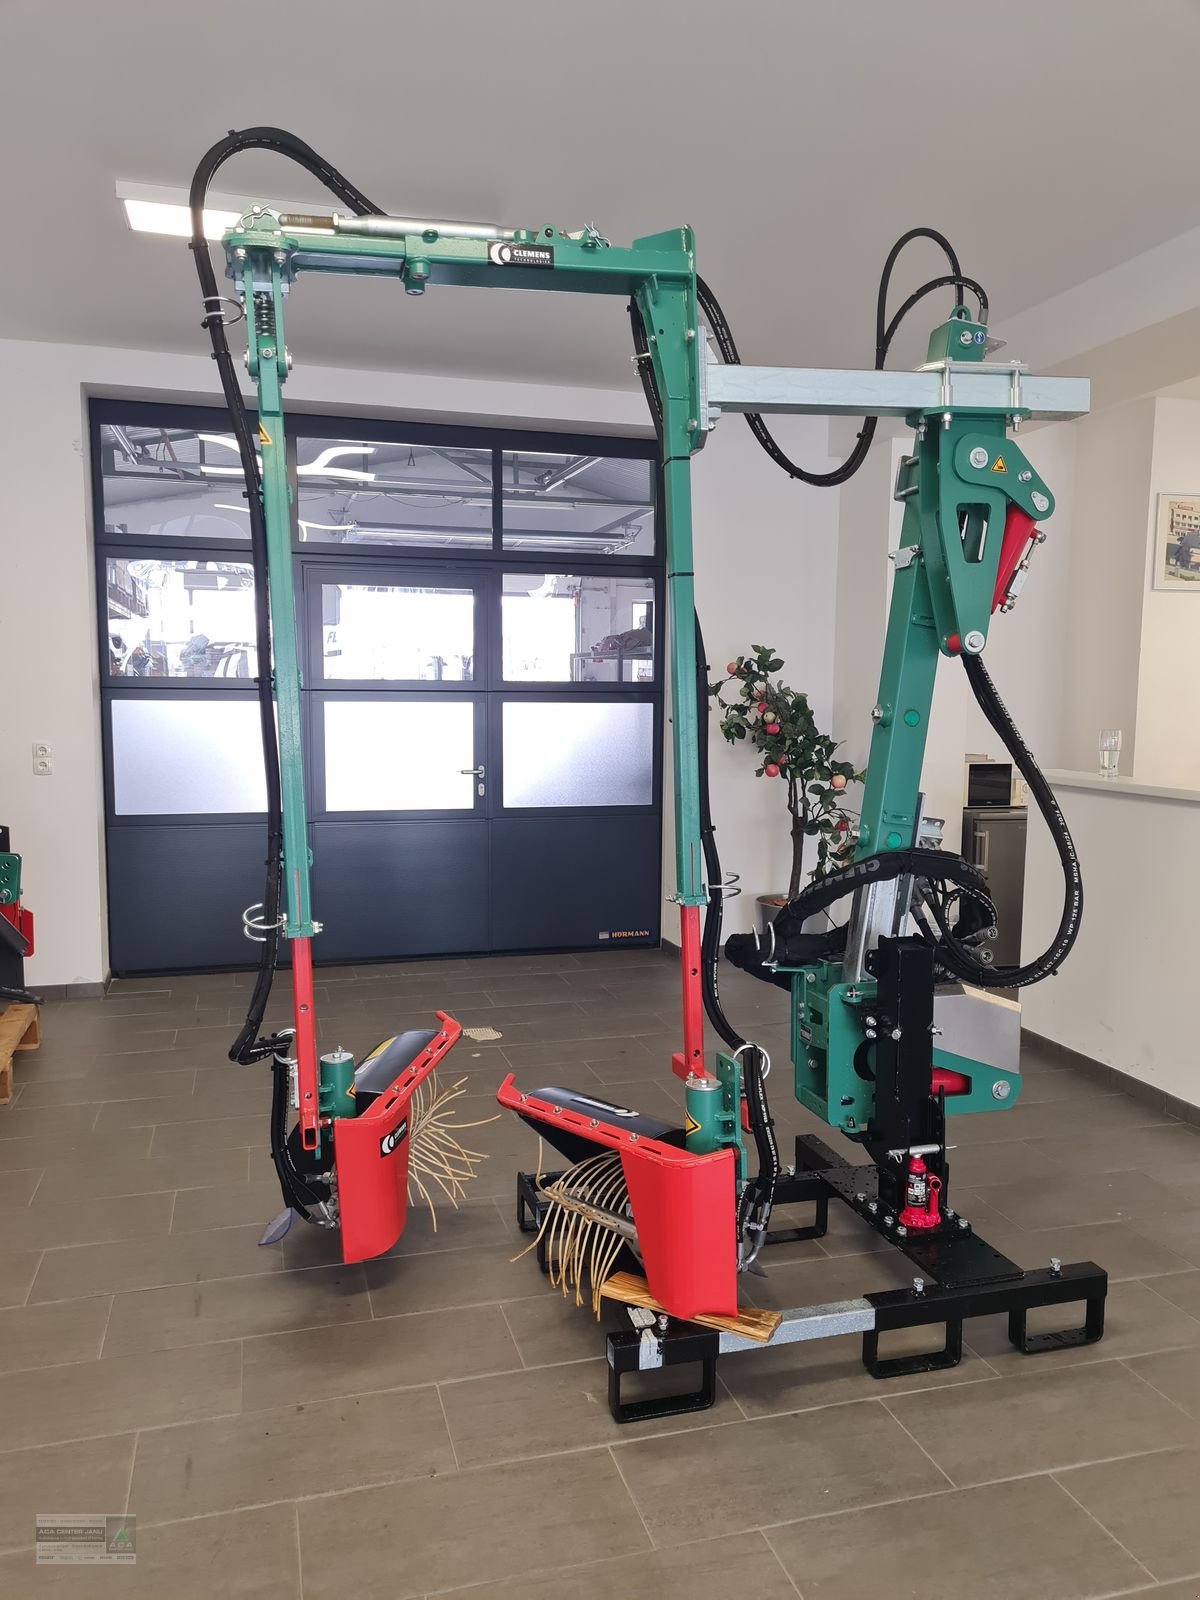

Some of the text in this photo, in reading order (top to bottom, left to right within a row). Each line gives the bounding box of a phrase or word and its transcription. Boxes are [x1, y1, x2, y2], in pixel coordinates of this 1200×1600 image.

[513, 249, 551, 259] CLEMENS
[1067, 923, 1074, 935] WP
[1071, 861, 1079, 883] MSHA
